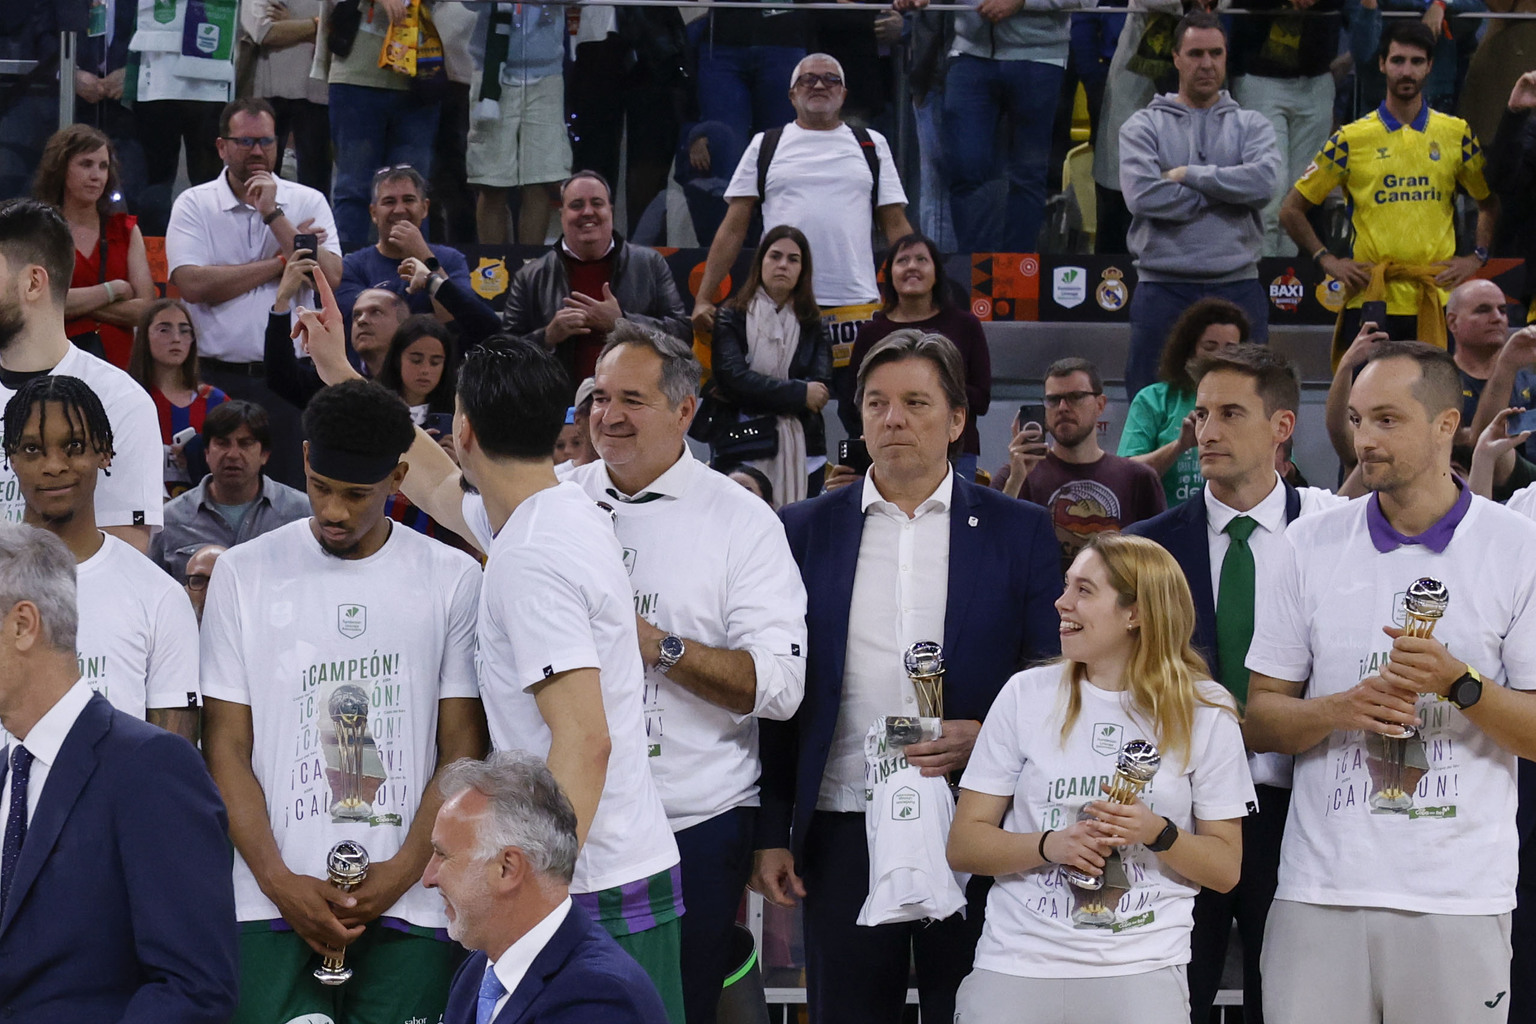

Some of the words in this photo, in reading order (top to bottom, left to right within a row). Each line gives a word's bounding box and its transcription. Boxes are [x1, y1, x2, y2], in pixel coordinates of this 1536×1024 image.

[1383, 174, 1429, 188] Gran
[1269, 285, 1303, 297] BAXI
[302, 649, 400, 691] ¡CAMPEÓN!
